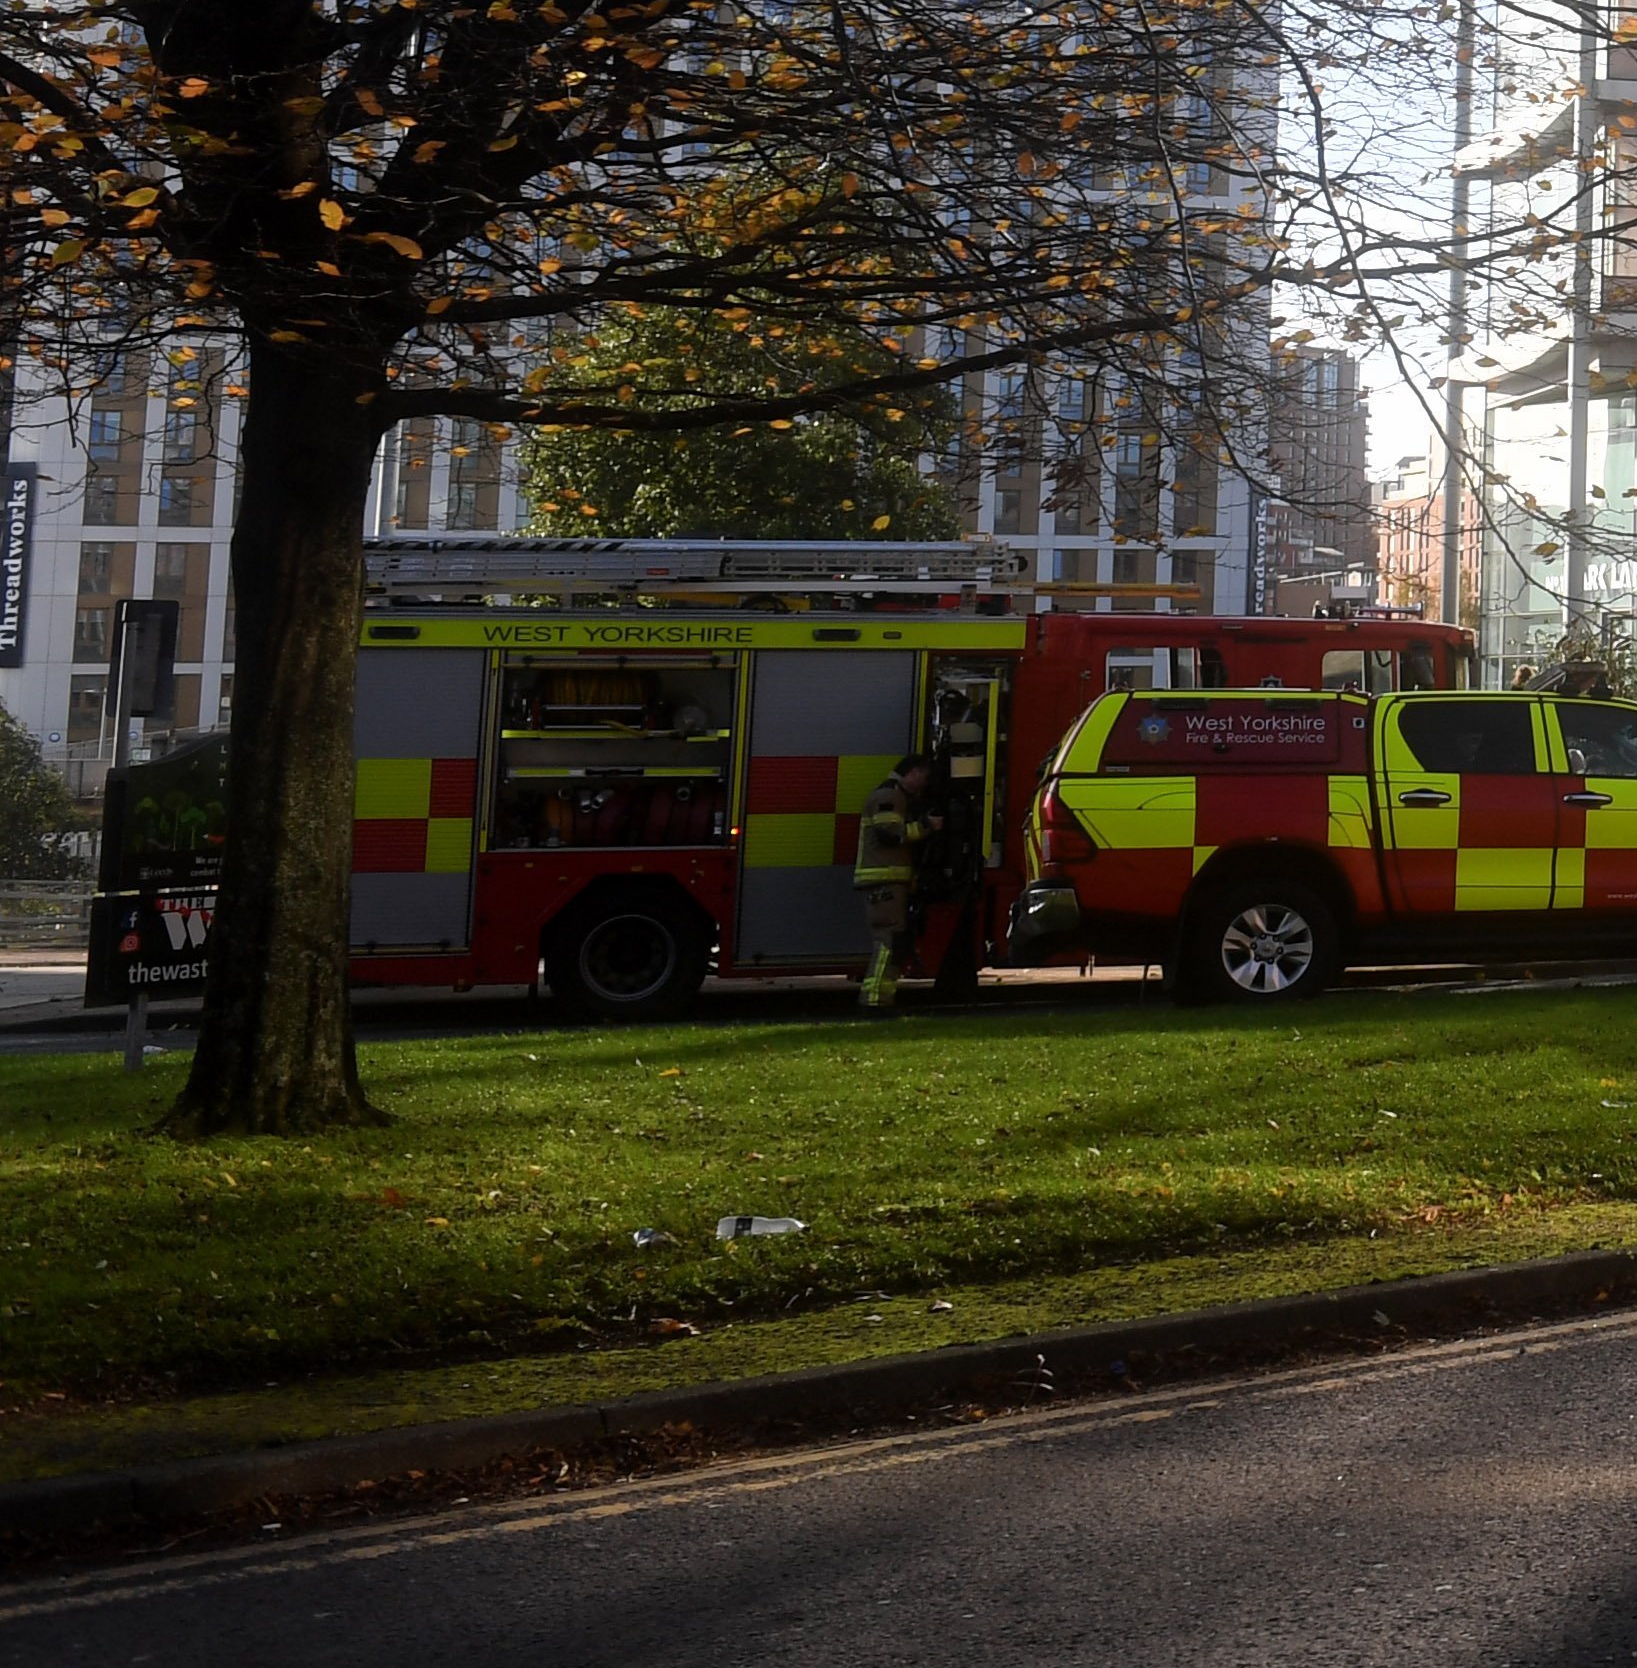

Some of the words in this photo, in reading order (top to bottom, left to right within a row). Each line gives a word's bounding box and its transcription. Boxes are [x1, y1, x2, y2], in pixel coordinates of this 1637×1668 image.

[0, 479, 28, 651] Threadworks
[1254, 498, 1267, 613] readworks
[483, 626, 571, 642] WEST
[583, 626, 753, 643] YORKSHIRE
[1185, 715, 1233, 731] West
[1240, 714, 1326, 731] Yorkshire
[1186, 733, 1209, 744] Fire
[1212, 733, 1223, 744] &
[1226, 733, 1274, 744] Rescue
[1278, 732, 1325, 744] Service
[128, 959, 209, 984] thewast
